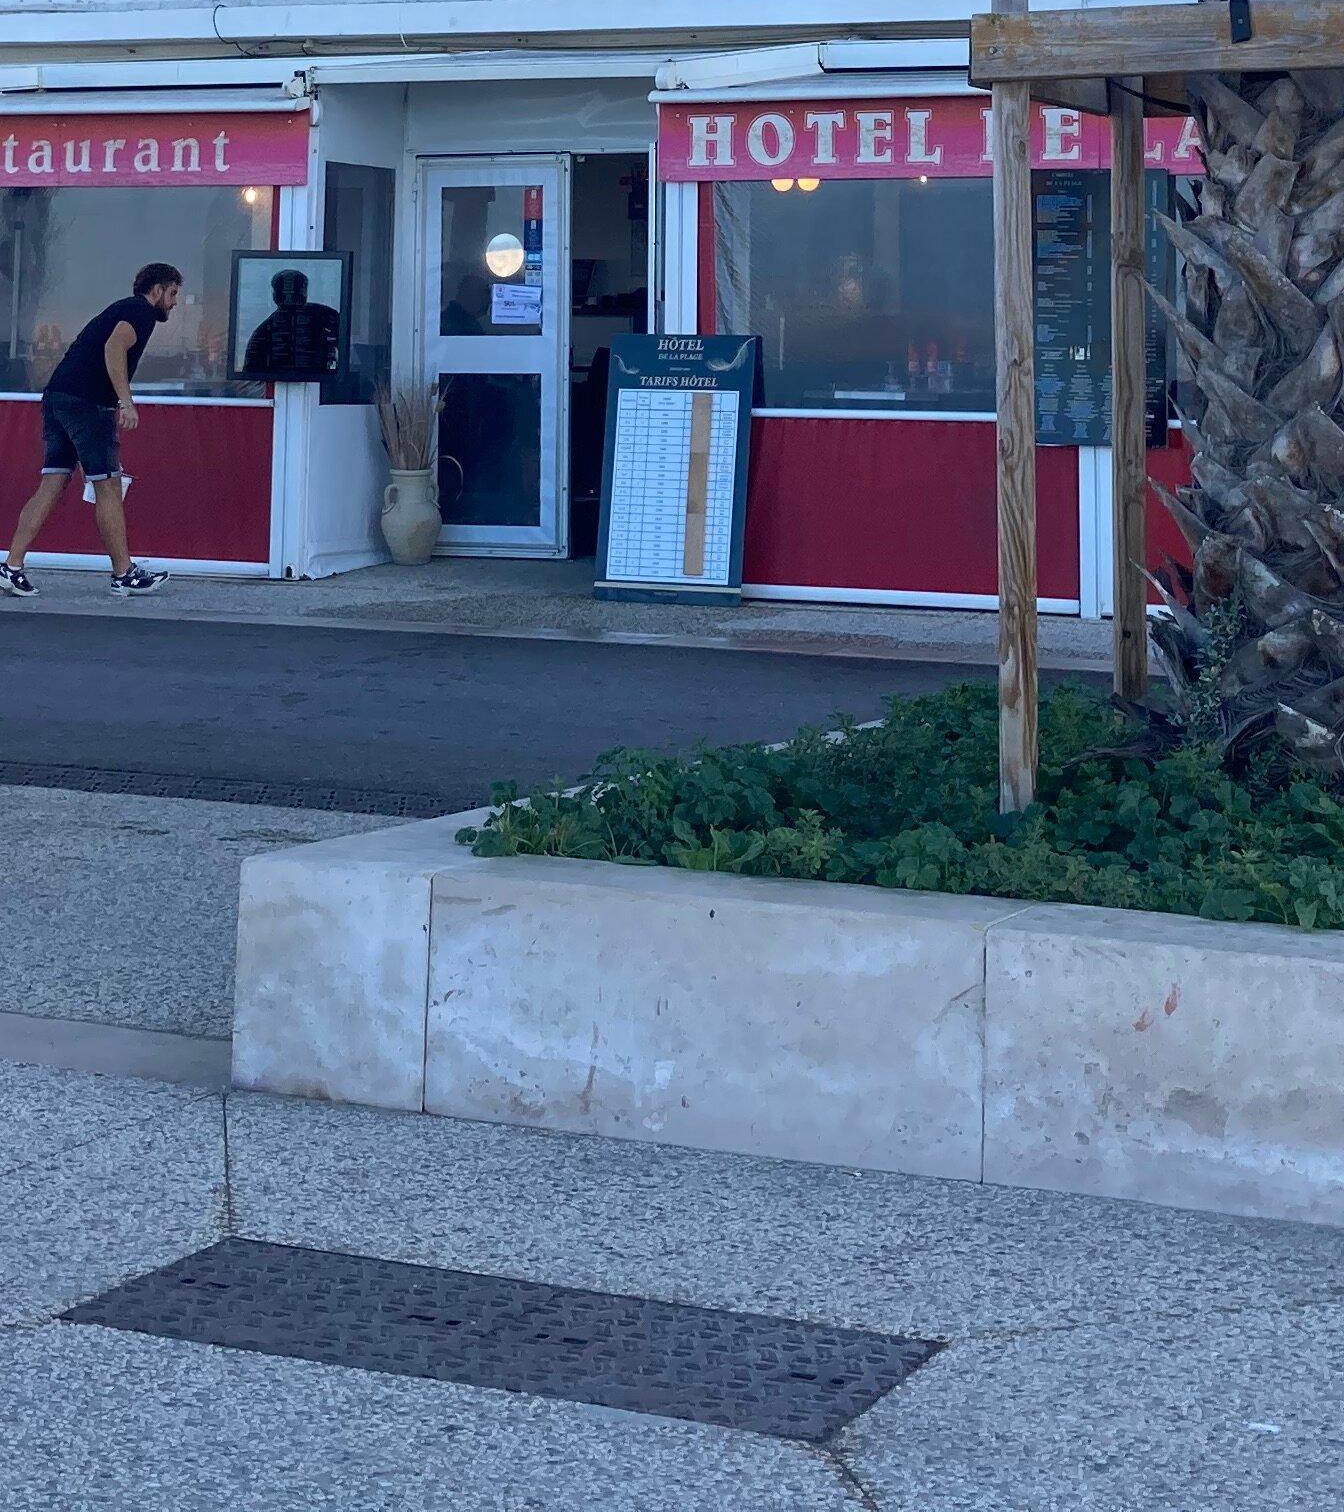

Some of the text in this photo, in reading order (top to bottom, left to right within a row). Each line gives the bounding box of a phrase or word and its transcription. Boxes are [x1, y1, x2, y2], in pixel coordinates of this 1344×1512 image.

[687, 108, 944, 167] HOTEL
[658, 336, 704, 351] HÔTEL
[640, 374, 718, 387] TARIFS HÔTEL
